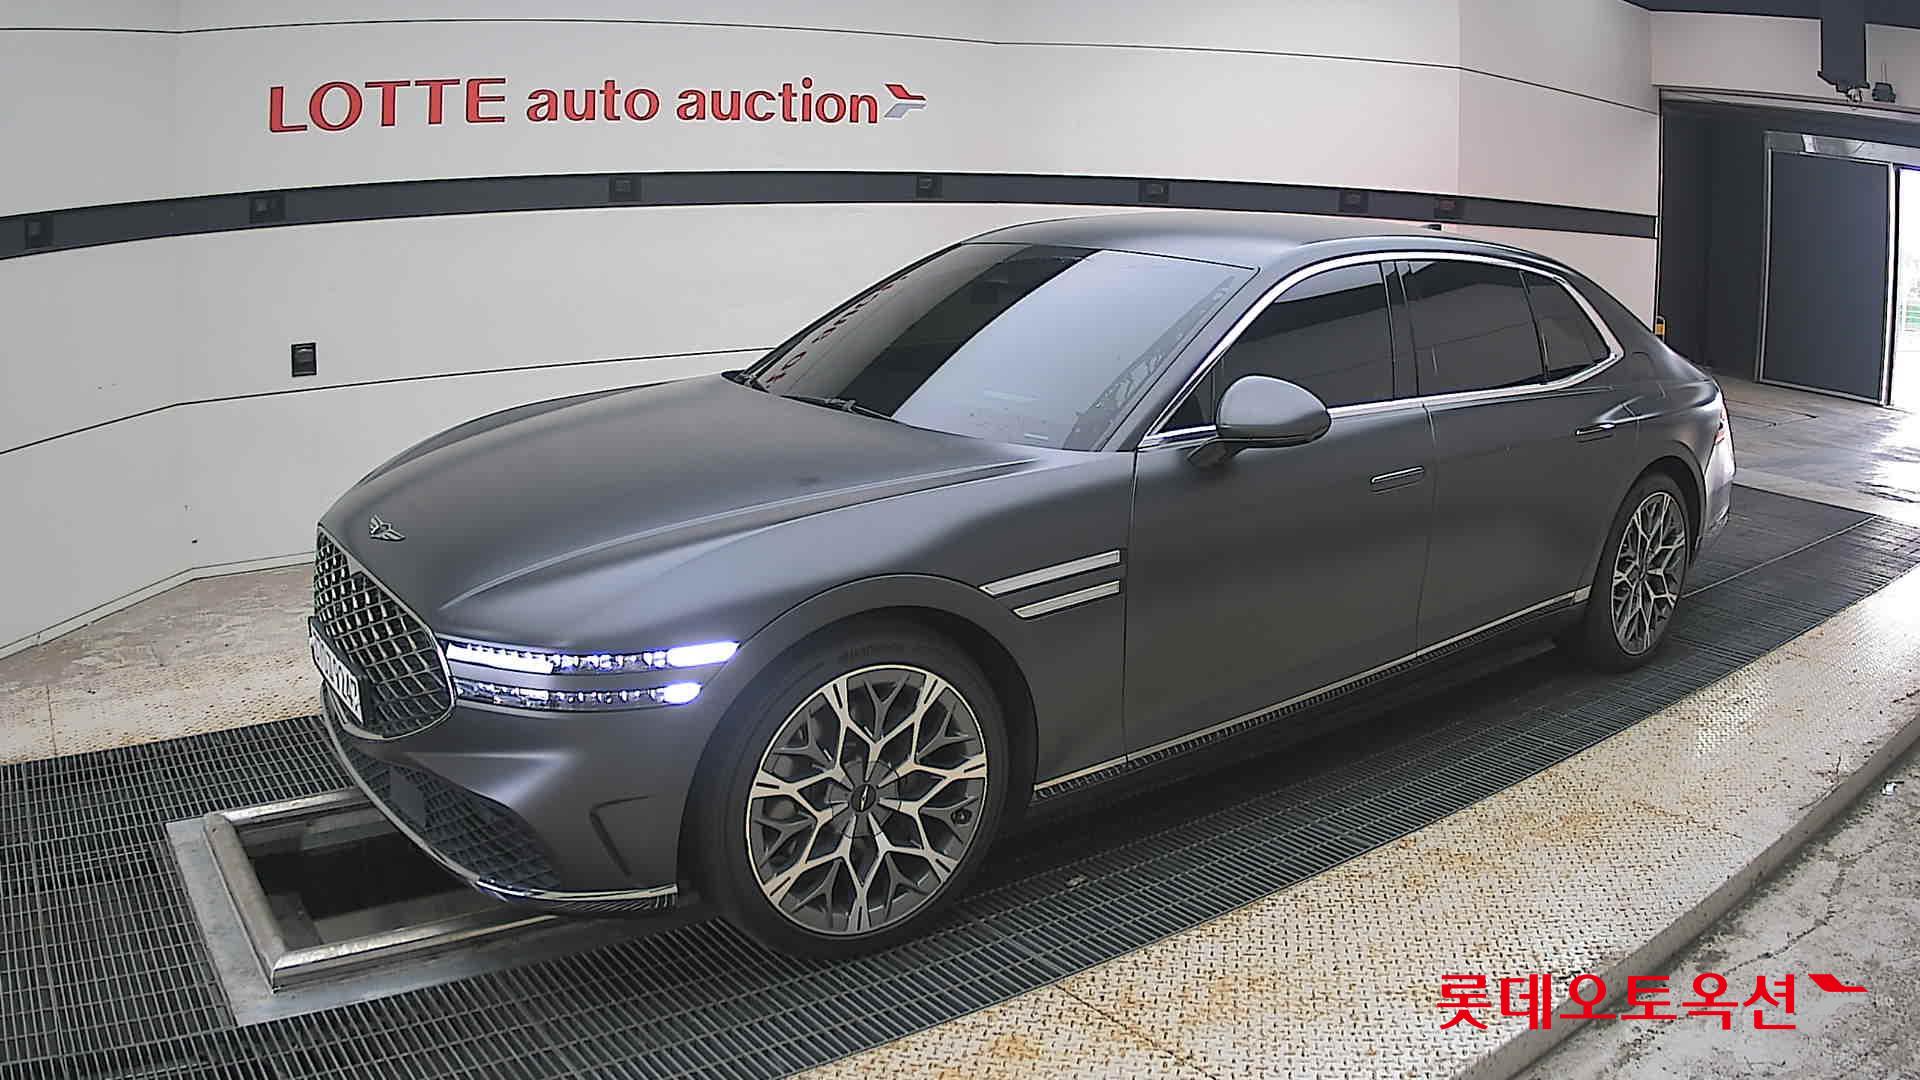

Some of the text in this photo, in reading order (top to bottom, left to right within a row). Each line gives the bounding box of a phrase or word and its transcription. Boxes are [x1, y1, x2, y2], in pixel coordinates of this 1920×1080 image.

[269, 78, 879, 133] LOTTE auto auction
